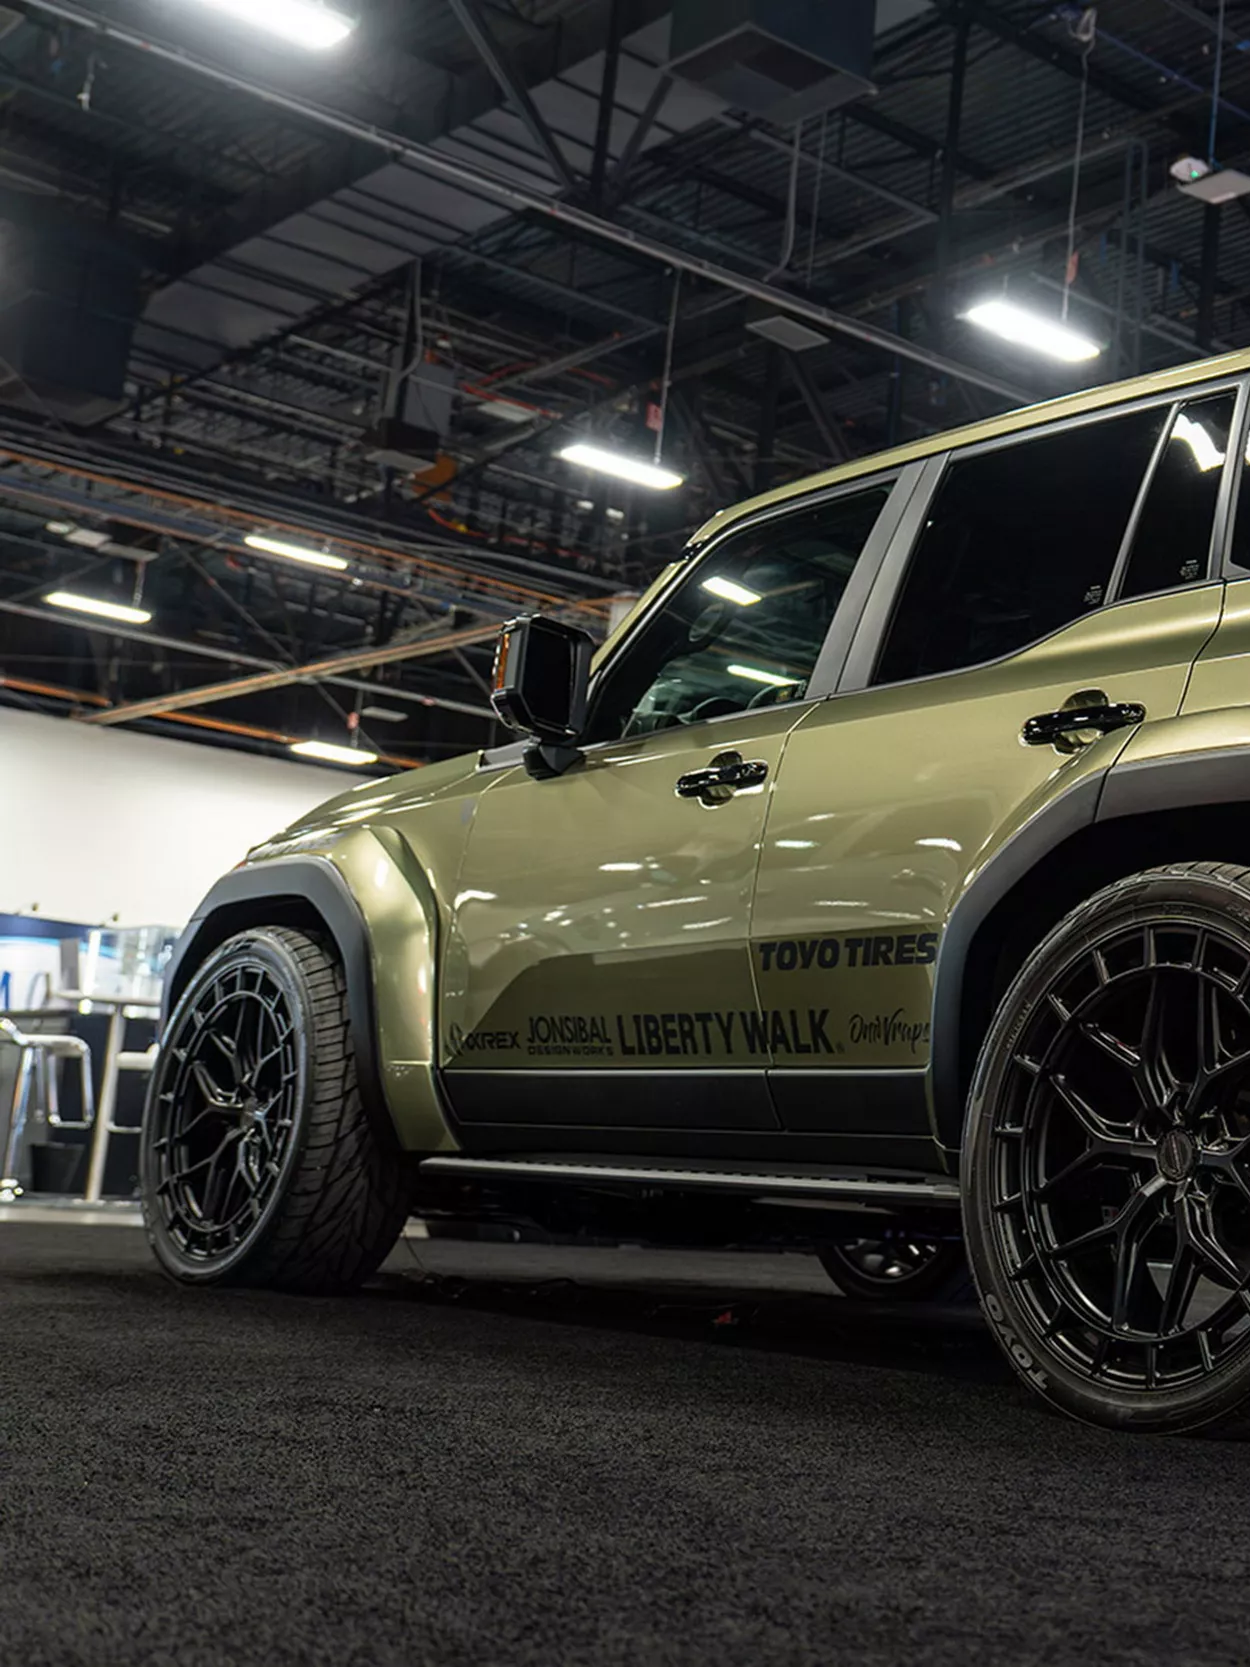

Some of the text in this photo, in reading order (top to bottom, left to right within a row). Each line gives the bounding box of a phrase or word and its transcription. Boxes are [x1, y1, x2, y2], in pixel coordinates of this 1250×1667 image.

[759, 932, 939, 972] TOYO TIRES
[527, 1016, 612, 1044] JONSIBAL
[616, 1009, 835, 1056] LIBERTY WALK
[985, 1293, 1050, 1390] TOYO
